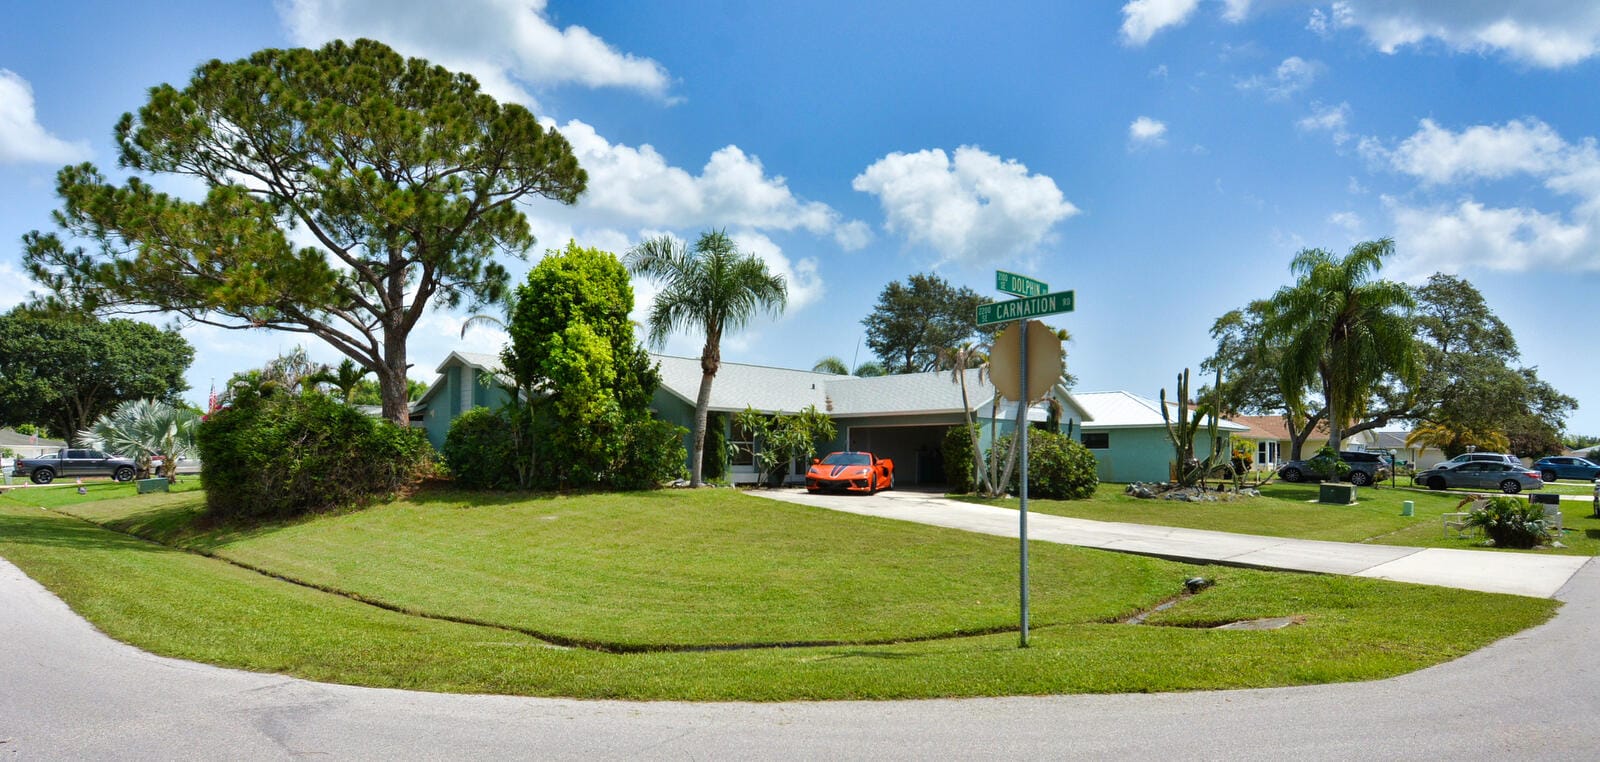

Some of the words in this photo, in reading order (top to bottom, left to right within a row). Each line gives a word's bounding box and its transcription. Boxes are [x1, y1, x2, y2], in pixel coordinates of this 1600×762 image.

[1011, 276, 1040, 296] DOLPHIN
[996, 296, 1056, 320] CARNATION
[1062, 298, 1071, 307] RD
